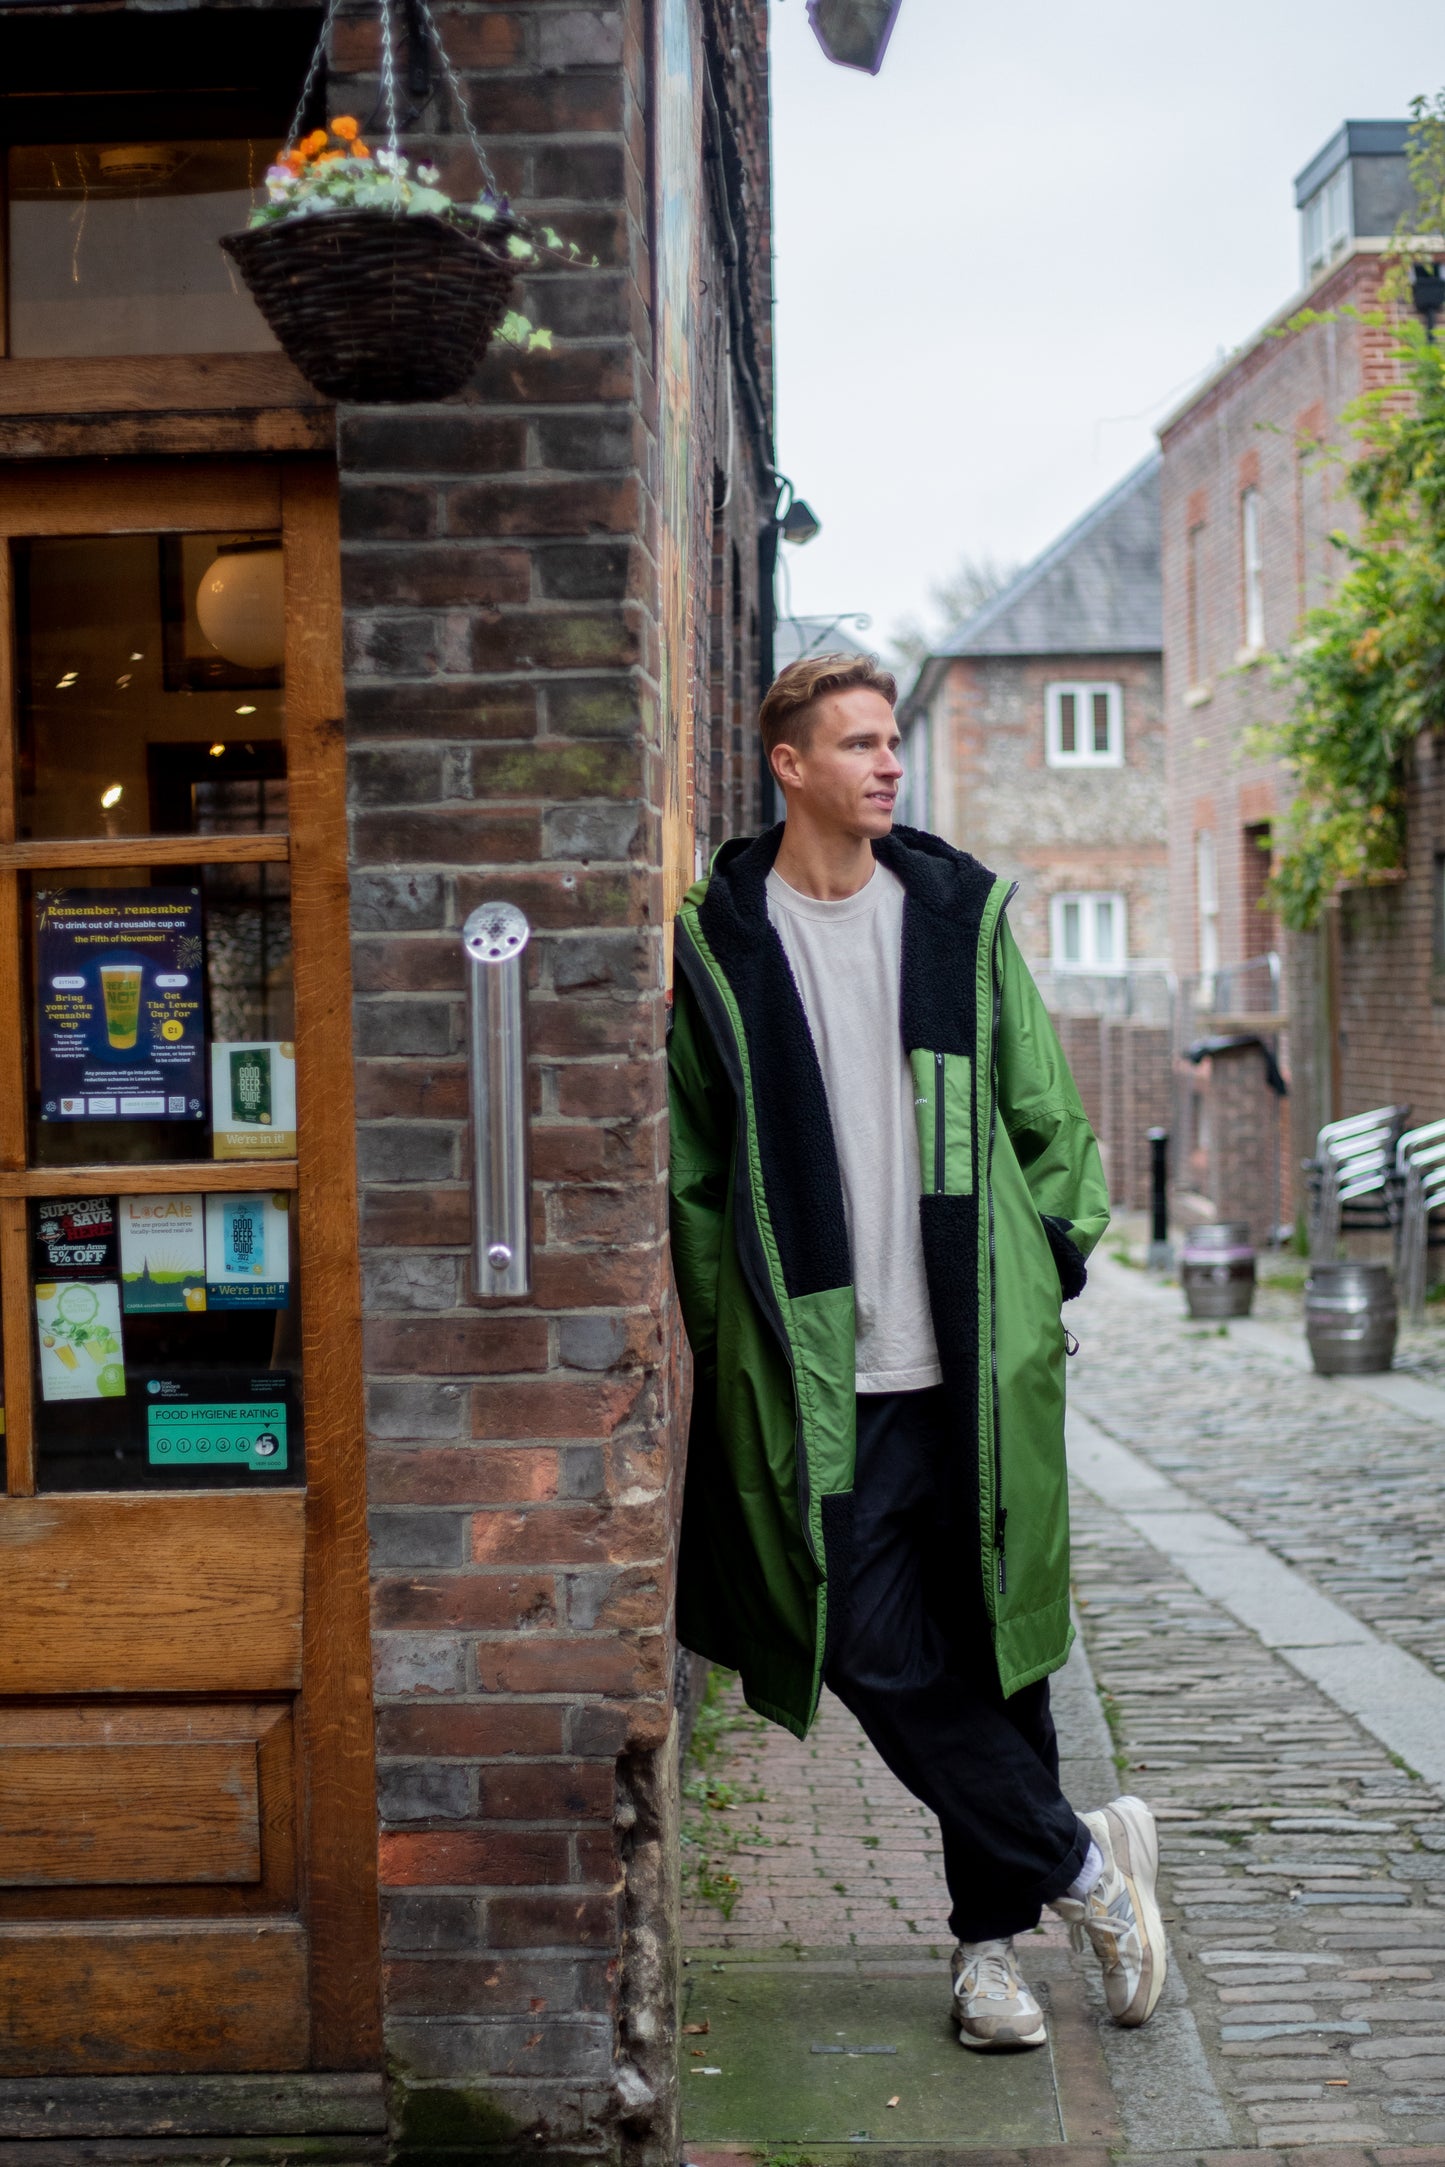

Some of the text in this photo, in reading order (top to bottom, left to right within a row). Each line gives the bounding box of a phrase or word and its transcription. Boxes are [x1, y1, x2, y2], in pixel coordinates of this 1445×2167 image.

[47, 904, 192, 917] Remember, remember
[65, 921, 87, 929] drink
[103, 921, 113, 929] of
[120, 920, 156, 929] reusable
[157, 922, 173, 930] cup
[175, 920, 185, 928] on
[75, 935, 89, 943] the
[90, 935, 109, 943] Fifth
[121, 934, 165, 943] November!
[55, 994, 83, 1003] Bring
[164, 992, 181, 1000] Get
[45, 1004, 69, 1013] your
[147, 1001, 199, 1009] The Lewes
[173, 1010, 191, 1018] for
[239, 1066, 260, 1078] GOOD
[240, 1079, 260, 1091] BEER
[240, 1091, 261, 1103] GUIDE
[226, 1134, 257, 1144] We're
[260, 1134, 272, 1144] in
[40, 1197, 110, 1219] SUPPORT
[72, 1209, 112, 1227] SAVE
[232, 1218, 253, 1230] GOOD
[233, 1230, 253, 1243] BEER
[233, 1242, 253, 1254] GUIDE
[49, 1250, 106, 1263] 5% OFF
[219, 1284, 276, 1295] We're in it!
[155, 1408, 279, 1420] FOOD HYGIENE RATING
[261, 1435, 274, 1450] 5
